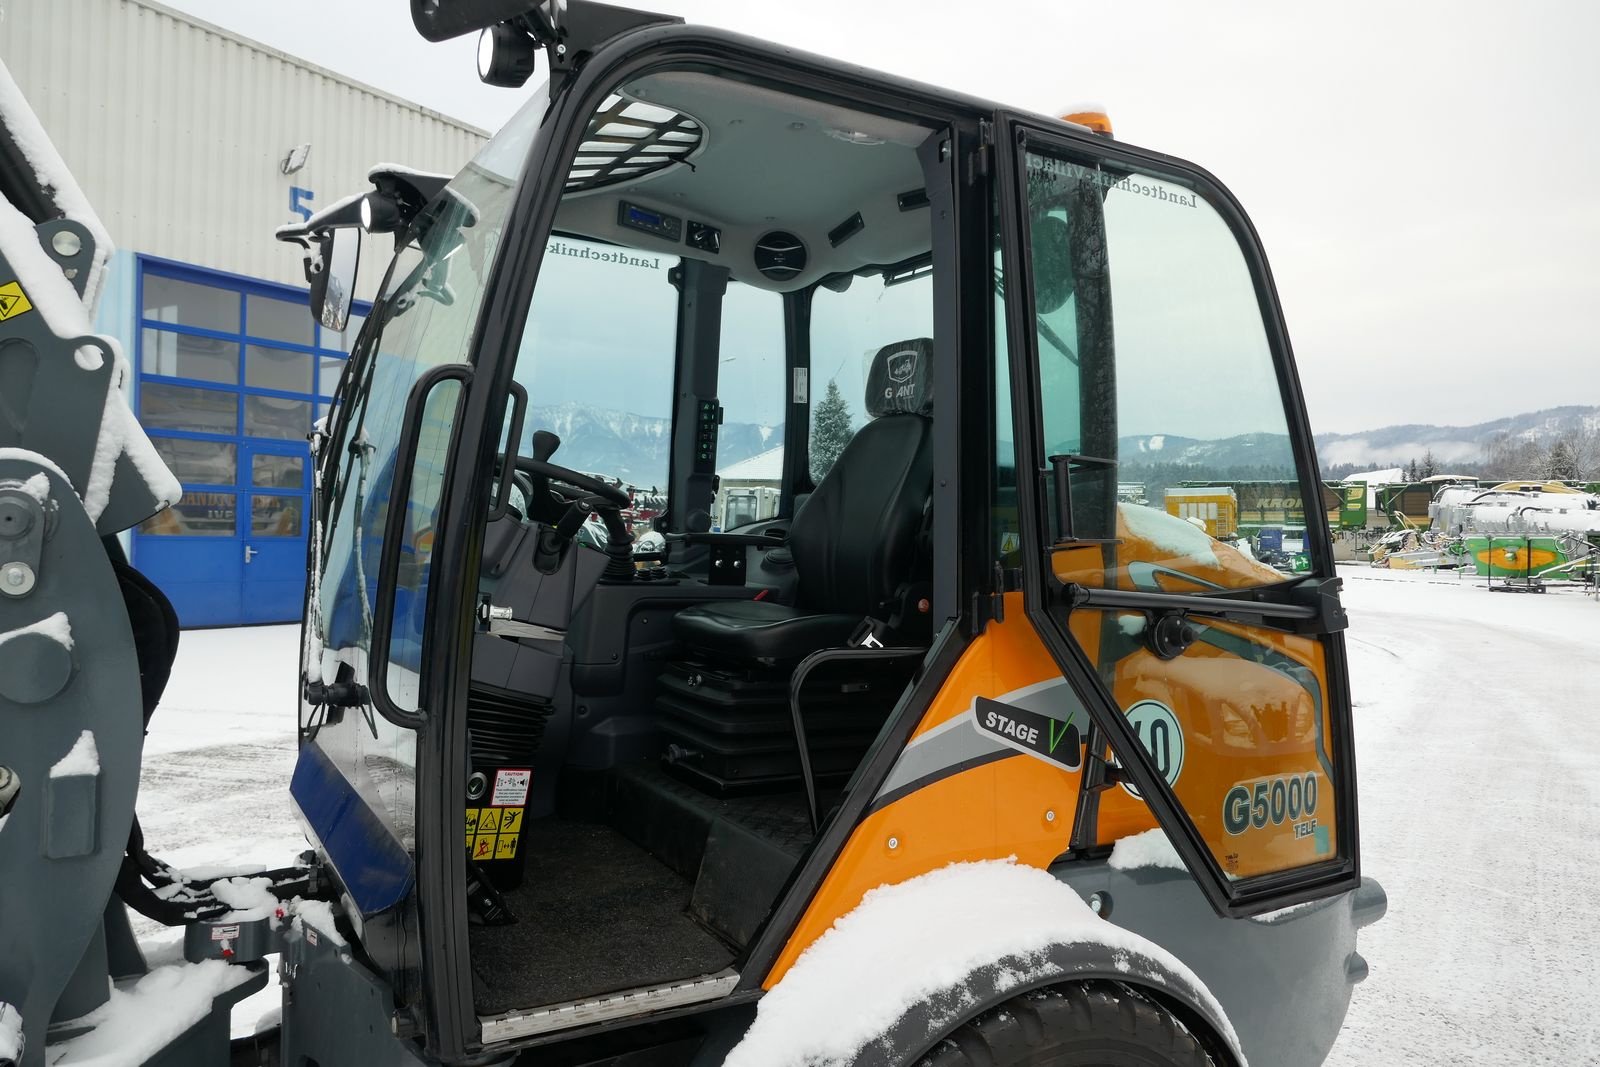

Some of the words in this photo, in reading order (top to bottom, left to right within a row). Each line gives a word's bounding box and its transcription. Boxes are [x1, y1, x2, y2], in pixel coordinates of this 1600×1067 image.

[288, 186, 314, 224] 5
[885, 384, 915, 398] GANT
[208, 509, 235, 520] IVE
[1257, 498, 1304, 508] KRON
[986, 711, 1039, 745] STAGE
[1048, 711, 1074, 754] V
[1134, 718, 1171, 778] 0
[1223, 771, 1317, 836] G5000
